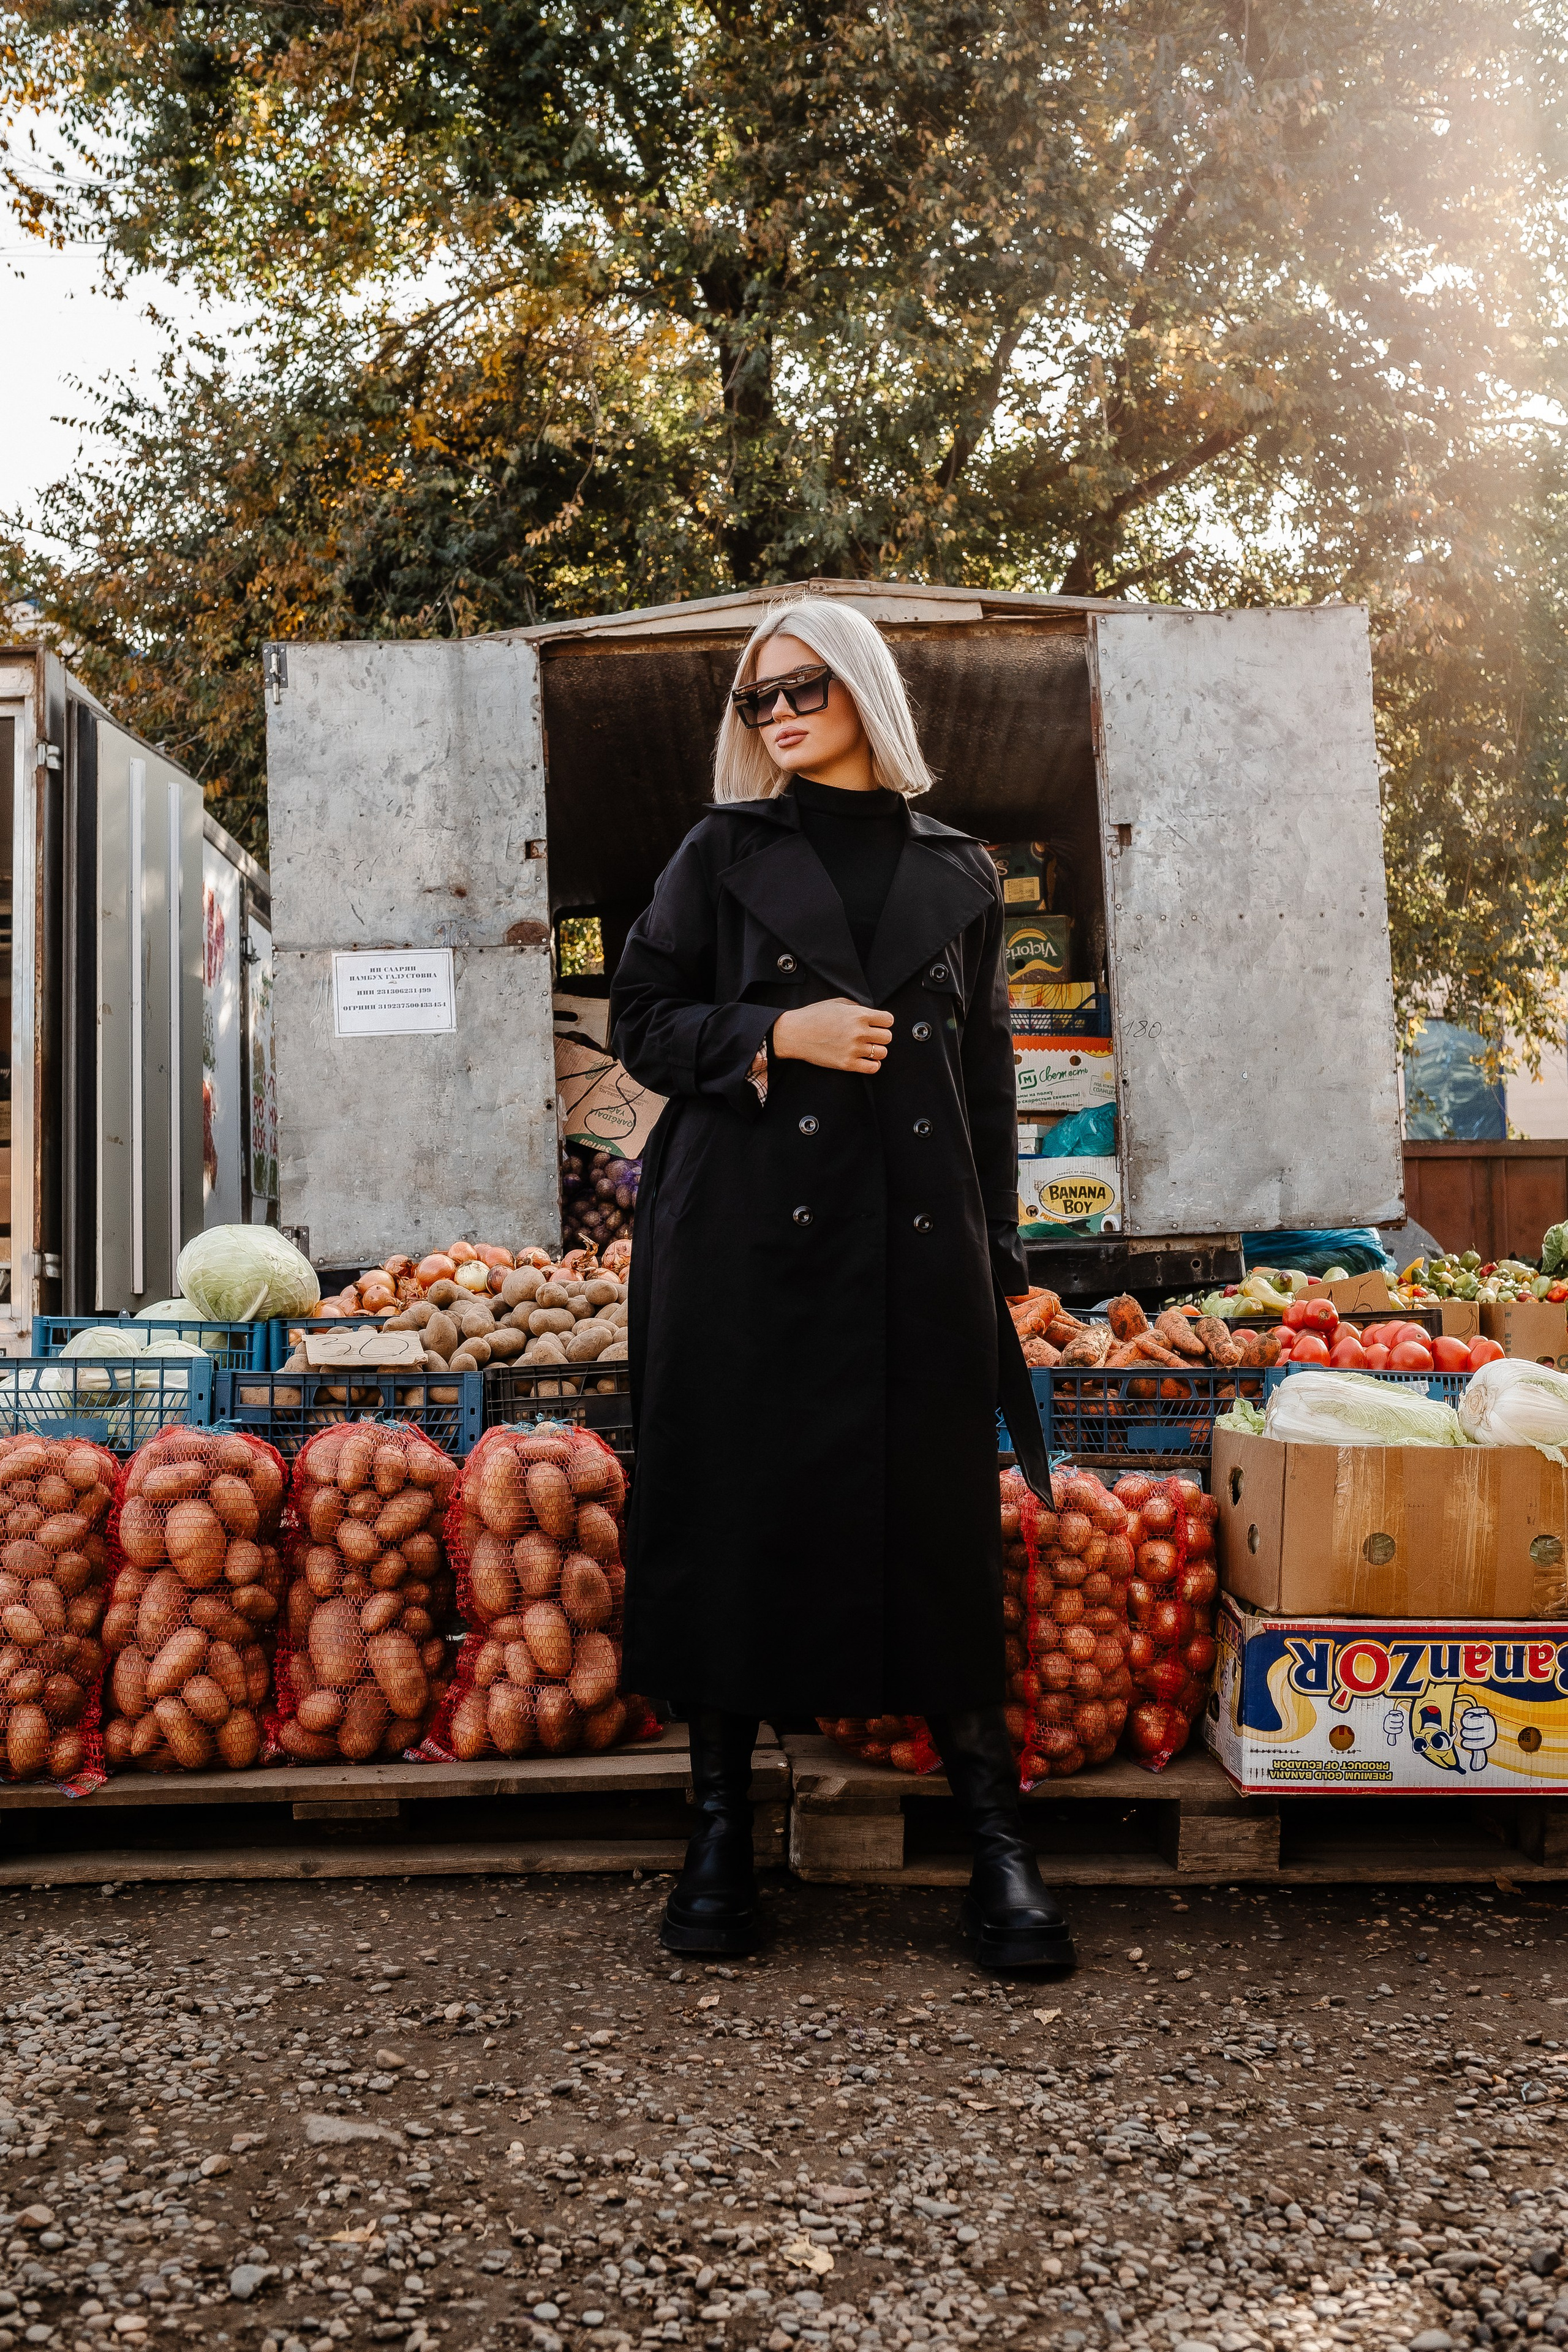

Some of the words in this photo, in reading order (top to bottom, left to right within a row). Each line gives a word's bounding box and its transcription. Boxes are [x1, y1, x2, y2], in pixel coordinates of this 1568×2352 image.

[1005, 941, 1058, 960] Victoria
[1123, 1020, 1162, 1038] 180
[1039, 1066, 1088, 1082] Свежесть
[1022, 1096, 1052, 1104] скоростью
[1052, 1091, 1080, 1100] свежести!
[1048, 1185, 1106, 1200] BANANA
[1062, 1199, 1093, 1215] BOY
[315, 1336, 409, 1358] 30
[1273, 1760, 1324, 1770] ECUADOR
[1325, 1760, 1340, 1770] OF
[1341, 1761, 1390, 1771] PRODUCT
[1268, 1770, 1314, 1779] BANANA
[1314, 1771, 1344, 1780] GOLD
[1345, 1771, 1393, 1781] PREMIUM
